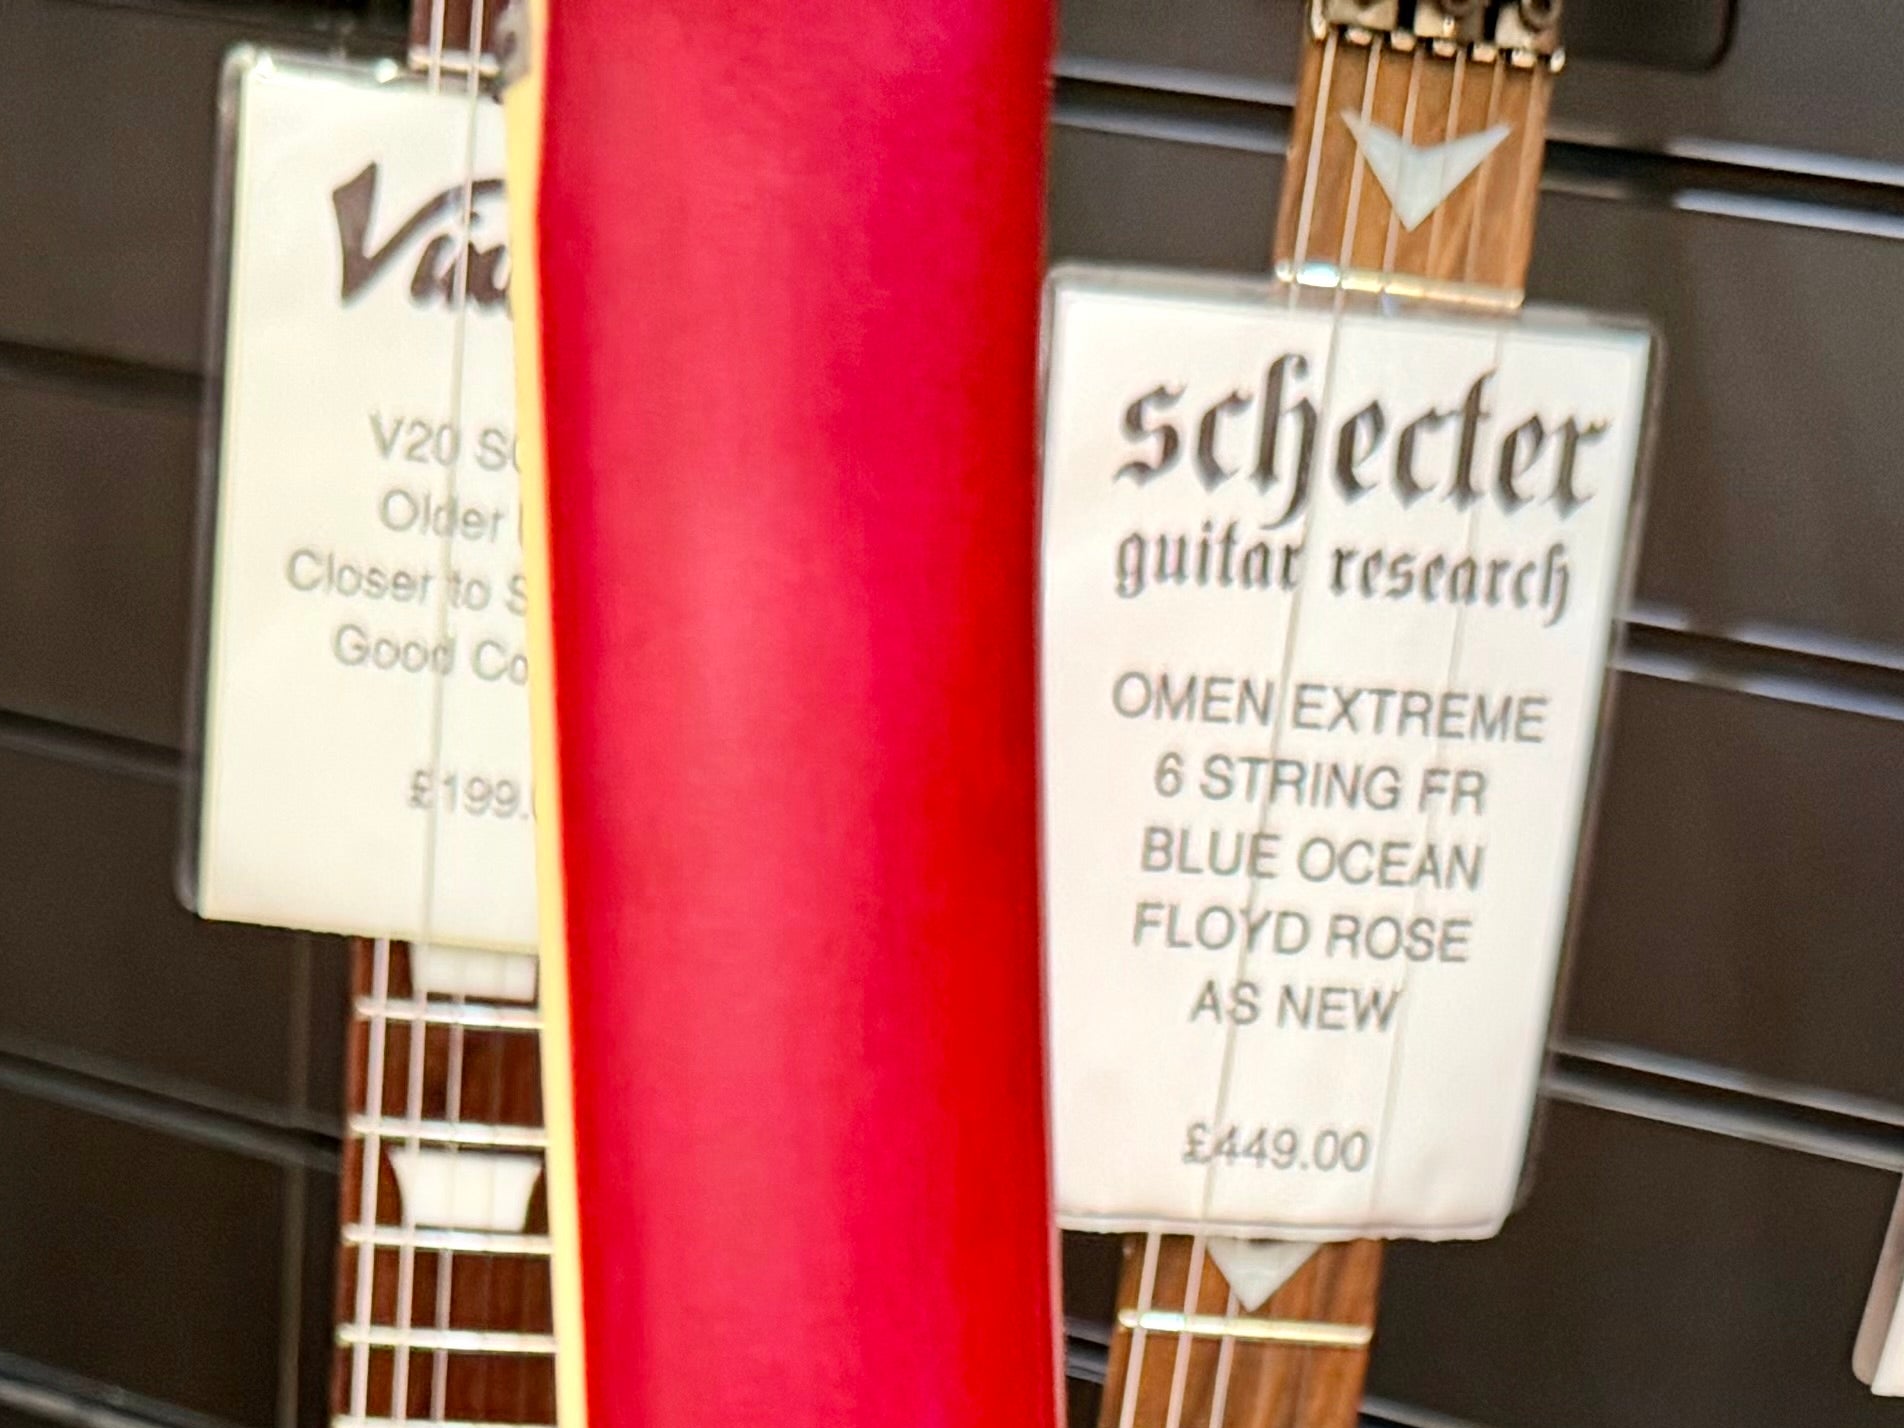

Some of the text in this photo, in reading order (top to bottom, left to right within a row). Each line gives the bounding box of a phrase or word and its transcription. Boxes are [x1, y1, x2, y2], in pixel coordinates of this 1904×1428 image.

[368, 409, 461, 468] V20
[1112, 352, 1616, 530] schecter
[378, 488, 505, 542] Older
[284, 546, 434, 608] Closer
[448, 569, 491, 613] to
[1113, 518, 1573, 630] guitar research
[332, 621, 457, 677] Good
[1111, 669, 1550, 745] OMEN EXTREME
[1153, 755, 1489, 817] 6 STRING FR
[1141, 826, 1485, 893] BLUE OCEAN
[1132, 902, 1475, 966] FLOYD ROSE
[1189, 979, 1405, 1035] AS NEW
[1181, 1121, 1372, 1174] £449.00
